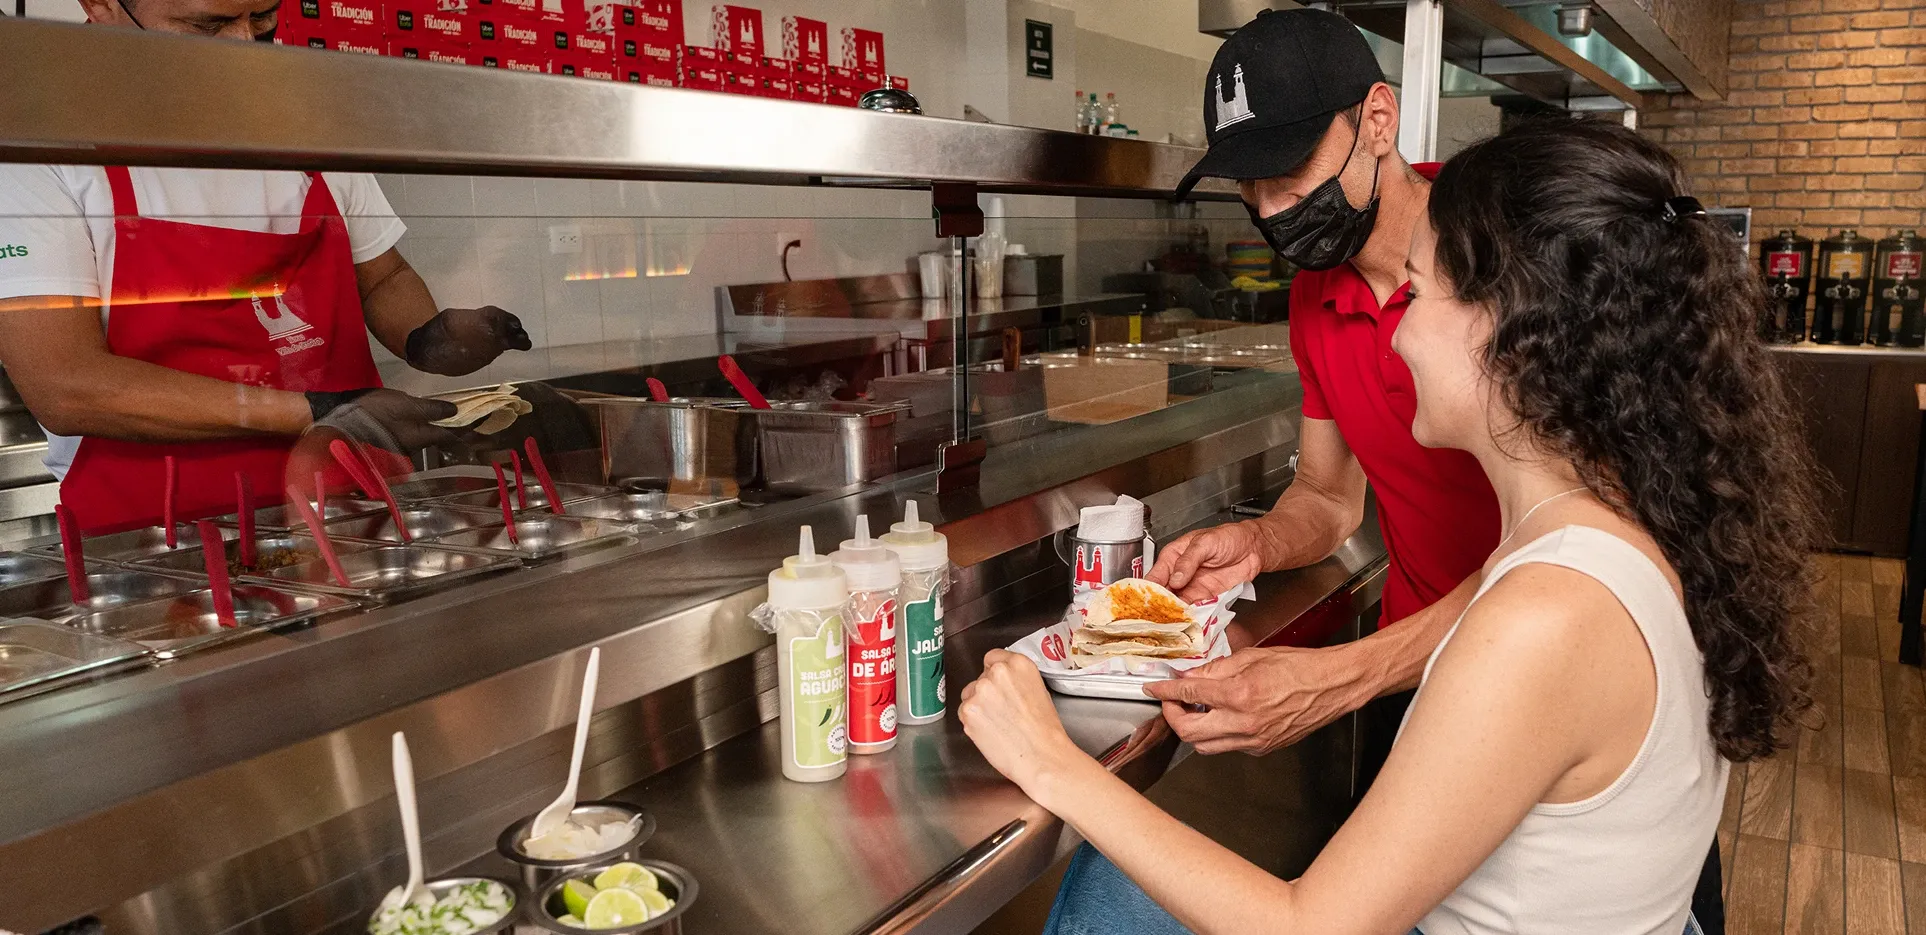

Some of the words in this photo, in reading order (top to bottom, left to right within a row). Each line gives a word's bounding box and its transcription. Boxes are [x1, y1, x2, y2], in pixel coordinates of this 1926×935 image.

[331, 5, 374, 21] TRADICIÓN
[424, 17, 462, 32] TRADICIÓN
[504, 27, 537, 41] TRADICIÓN
[861, 646, 891, 660] SALSA
[801, 669, 831, 681] SALSA
[852, 662, 876, 678] DE
